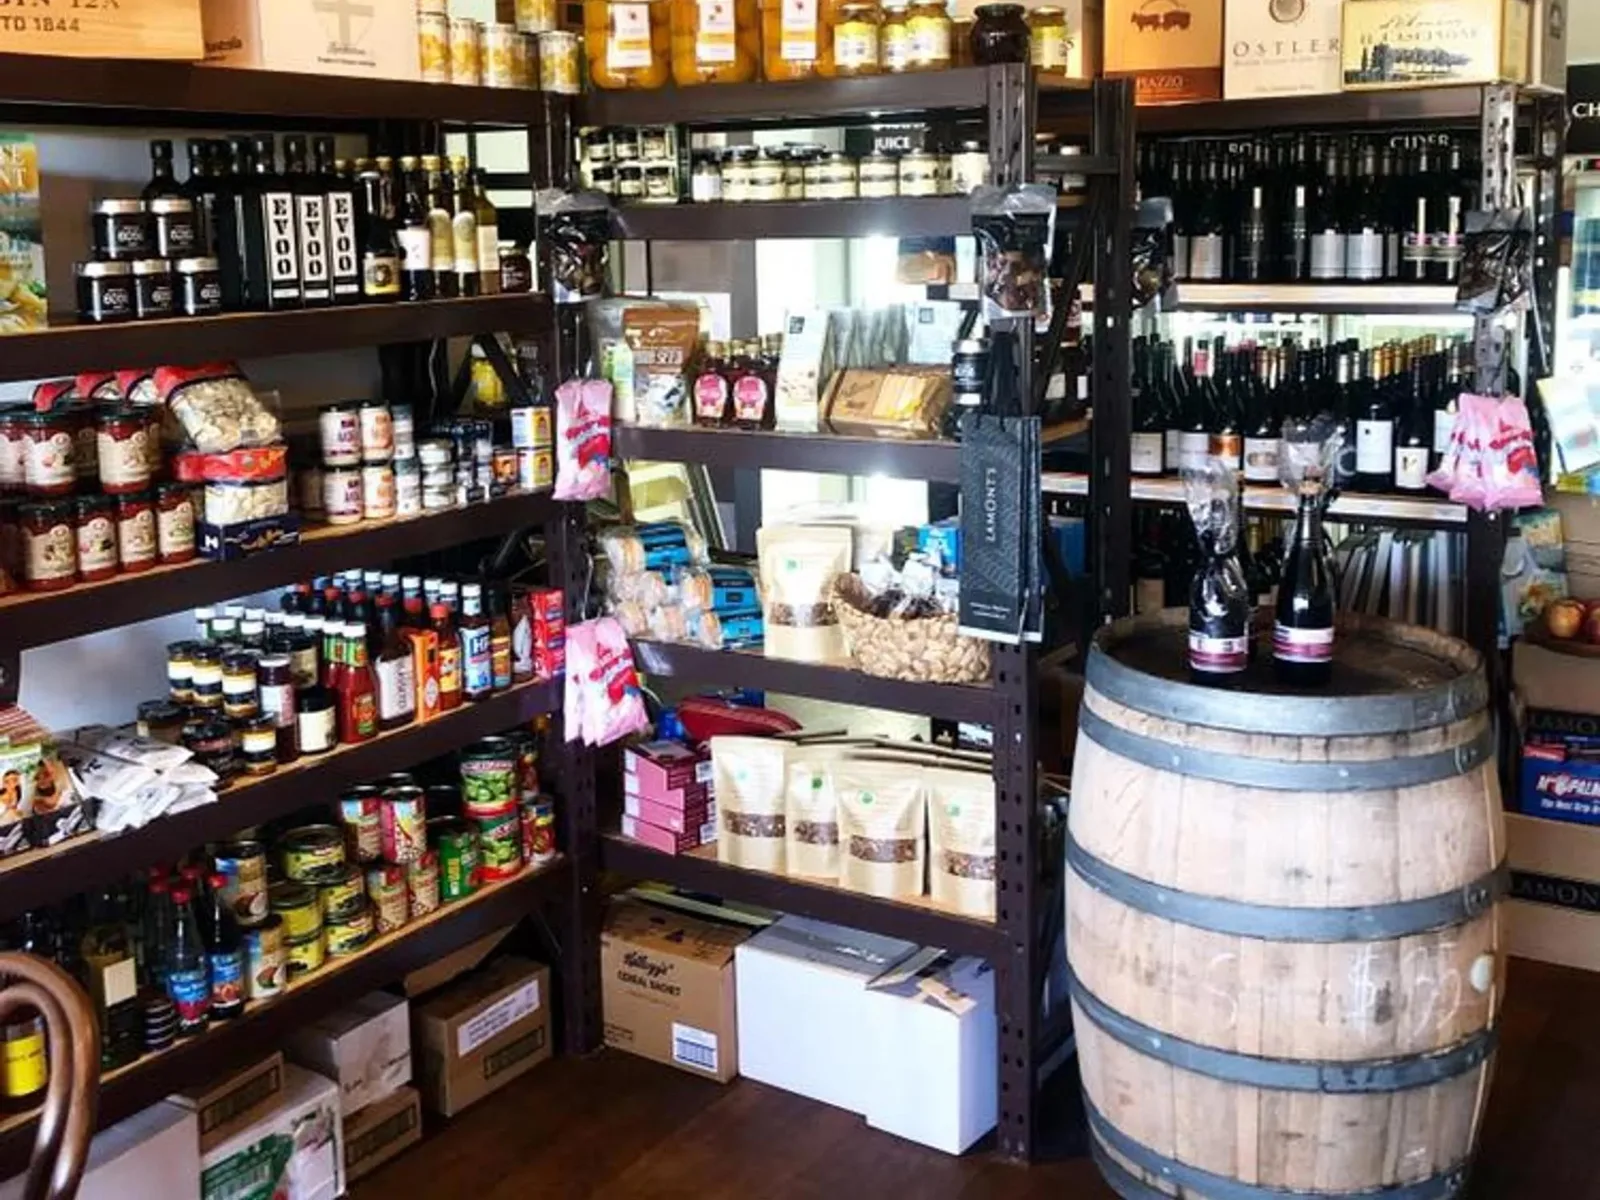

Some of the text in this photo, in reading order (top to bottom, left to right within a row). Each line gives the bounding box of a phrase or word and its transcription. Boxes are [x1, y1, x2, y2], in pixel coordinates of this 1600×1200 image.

[33, 17, 80, 31] 1844
[1233, 38, 1341, 57] OSTLER
[874, 136, 910, 151] JUICE
[273, 198, 292, 275] EVOO
[305, 201, 323, 276] EVOO
[334, 198, 353, 271] EVOO
